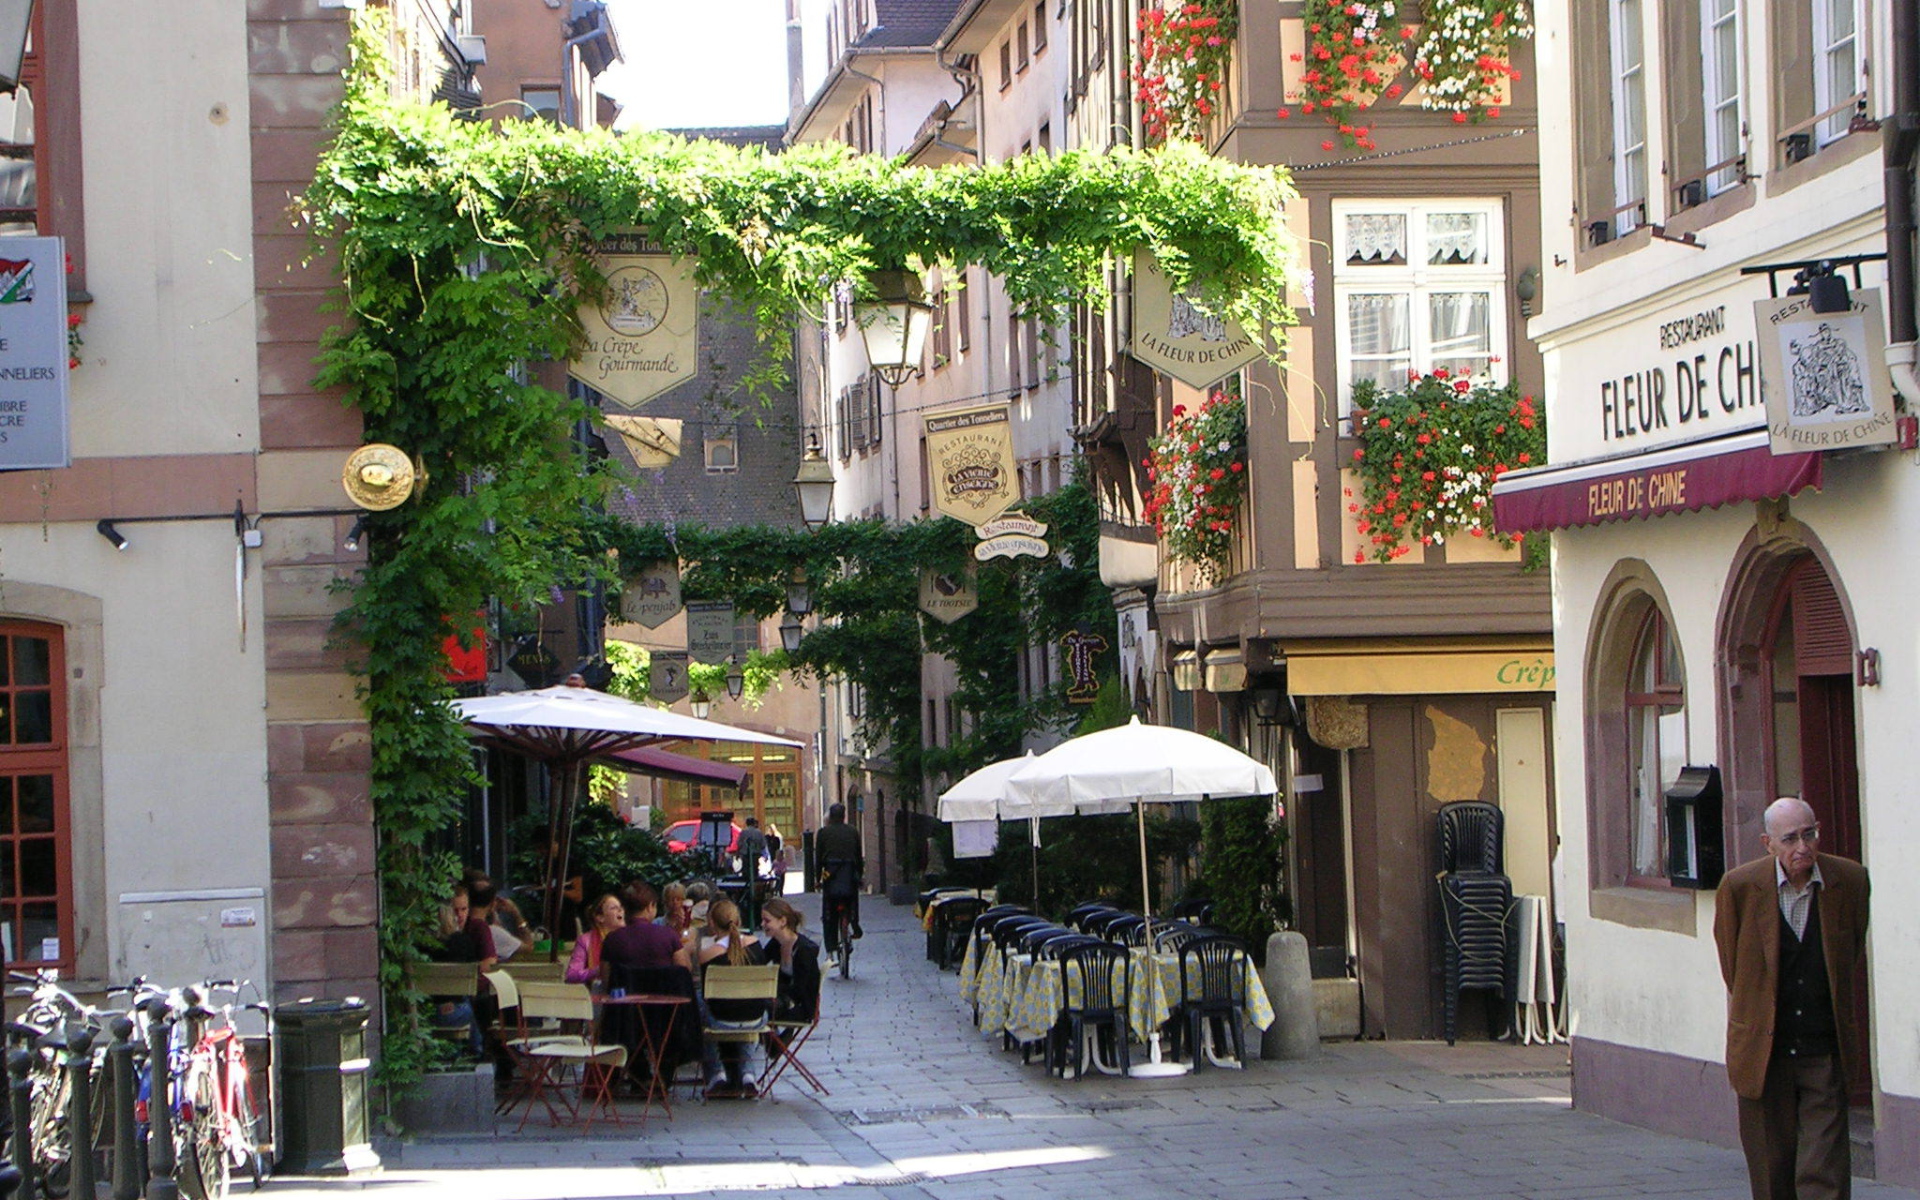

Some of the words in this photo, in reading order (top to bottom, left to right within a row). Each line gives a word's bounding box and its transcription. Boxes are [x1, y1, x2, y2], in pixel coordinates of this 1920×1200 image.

[619, 236, 638, 251] des
[1659, 304, 1726, 350] RESTAURANT
[1141, 332, 1157, 350] LA
[1157, 342, 1195, 364] FLEUR
[1198, 350, 1216, 364] DE
[1217, 337, 1252, 360] CHIN
[599, 353, 679, 380] Gourmande
[1601, 366, 1668, 441] FLEUR
[1676, 354, 1709, 423] DE
[1718, 340, 1764, 413] CHI
[929, 420, 957, 432] Quartier
[957, 416, 970, 427] des
[969, 411, 1006, 425] Tonneliers
[1791, 428, 1829, 445] FLEUR
[1853, 412, 1893, 439] CHINE
[938, 434, 1002, 454] RESTAURANT
[1588, 480, 1625, 517] FLEUR
[1627, 477, 1645, 510] DE
[1648, 470, 1687, 508] CHINE
[983, 521, 1039, 537] Restaurant
